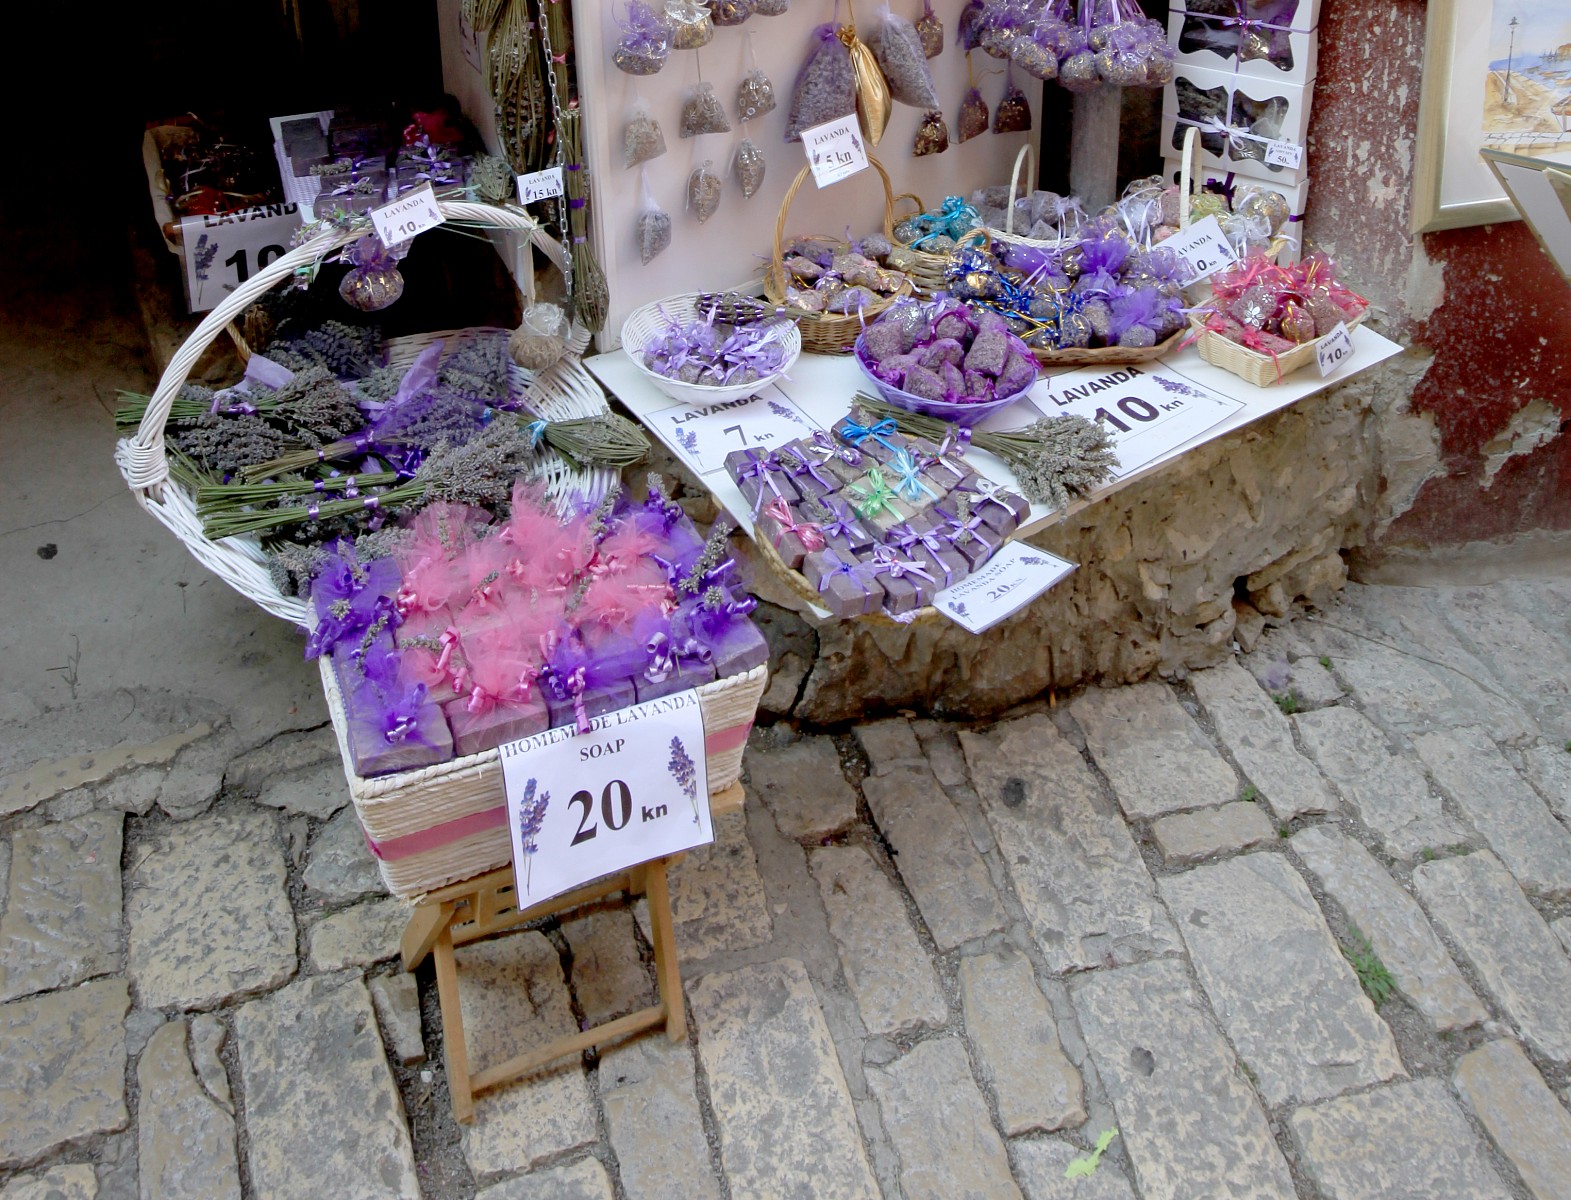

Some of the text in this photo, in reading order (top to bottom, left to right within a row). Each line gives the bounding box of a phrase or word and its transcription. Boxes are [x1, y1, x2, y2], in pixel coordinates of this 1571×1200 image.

[814, 127, 850, 145] LAVANDA
[826, 151, 852, 169] 5 kn
[1277, 155, 1287, 164] 50
[529, 174, 555, 185] LAVANDA
[533, 188, 558, 200] 15 kn
[203, 202, 298, 228] LAVAND
[384, 198, 425, 219] LAVANDA
[398, 221, 417, 236] 10
[1177, 234, 1213, 256] AVANDA
[1320, 330, 1343, 350] LAVANDA
[1327, 348, 1342, 364] 10
[1048, 366, 1145, 407] LAVANDA
[670, 393, 764, 424] LAVANDA
[1093, 396, 1184, 433] 10 kn
[723, 424, 774, 446] 7 kn
[950, 562, 1003, 594] HOMEMADE
[951, 558, 1016, 600] LAVANDA SOAP
[986, 584, 1011, 600] 20
[504, 694, 697, 758] HOMEMDE LAVANDA
[580, 738, 625, 762] SOAP
[567, 779, 668, 847] 20 kn
